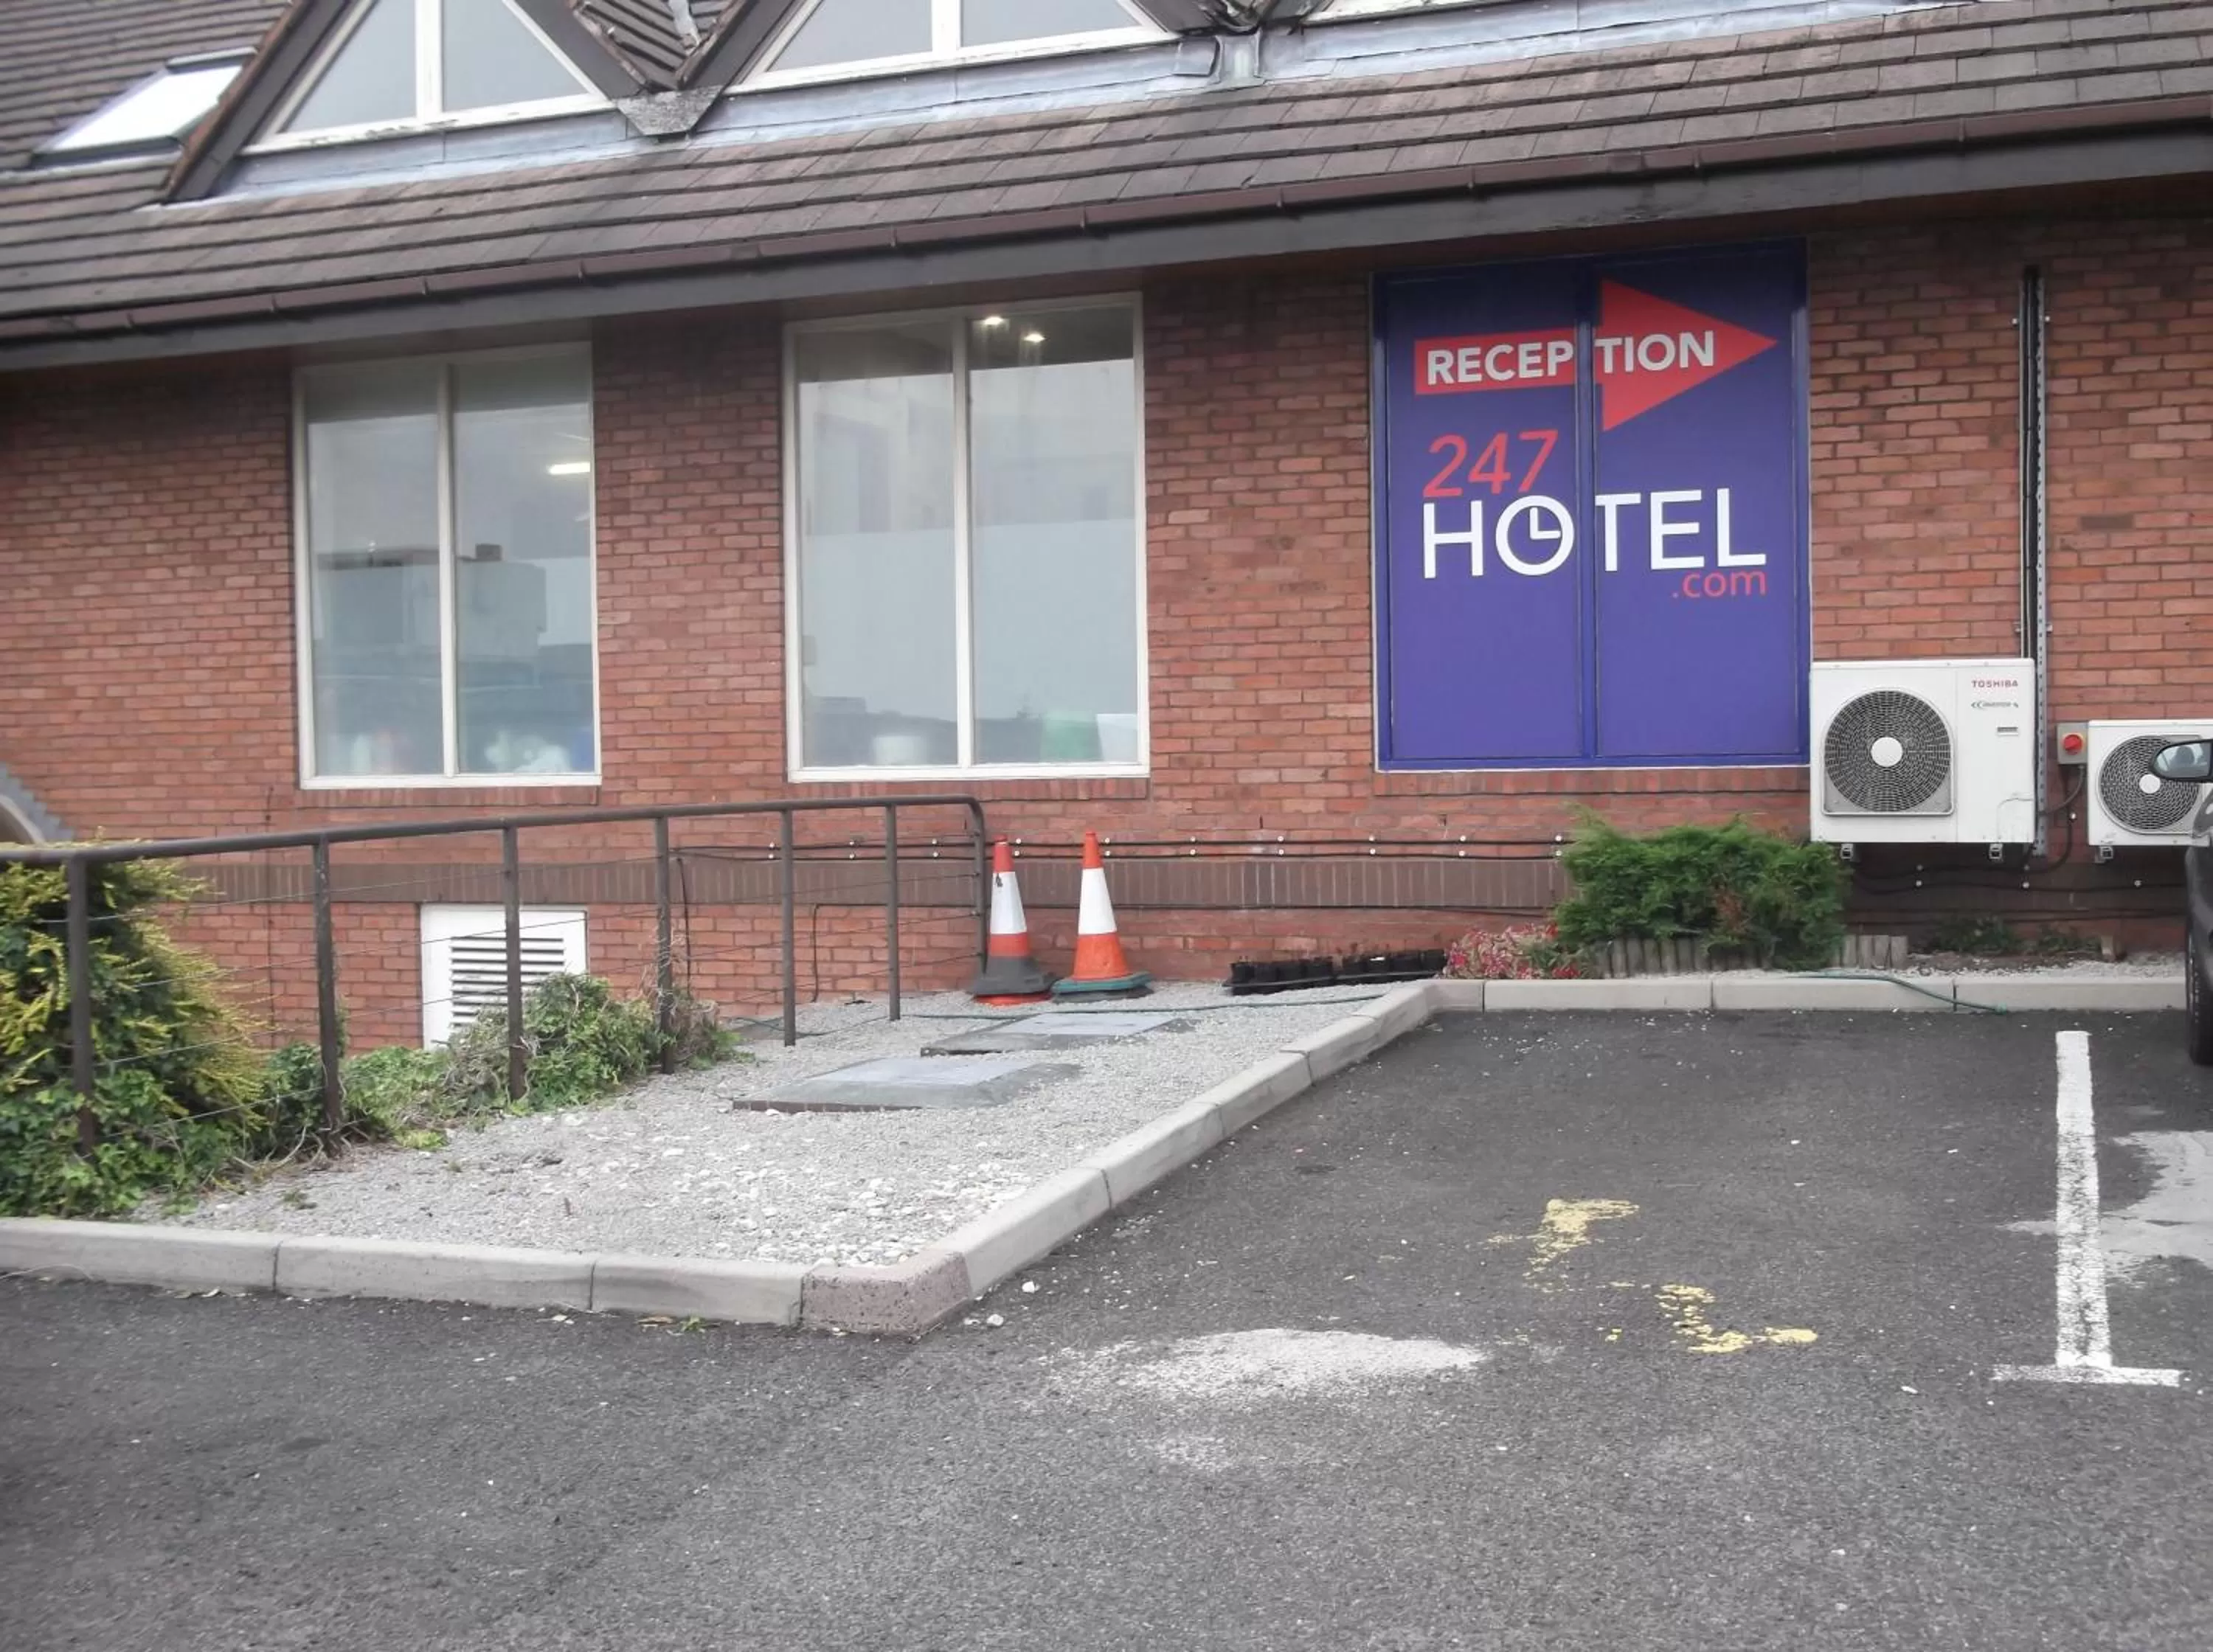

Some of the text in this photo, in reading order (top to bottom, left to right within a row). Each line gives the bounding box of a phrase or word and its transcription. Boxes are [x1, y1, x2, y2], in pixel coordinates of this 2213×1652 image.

[1427, 330, 1714, 385] RECEPTION
[1422, 429, 1559, 498] 247
[1422, 487, 1767, 579] HOTEL
[1672, 570, 1767, 599] .com
[1970, 679, 2018, 688] TOSHIBA
